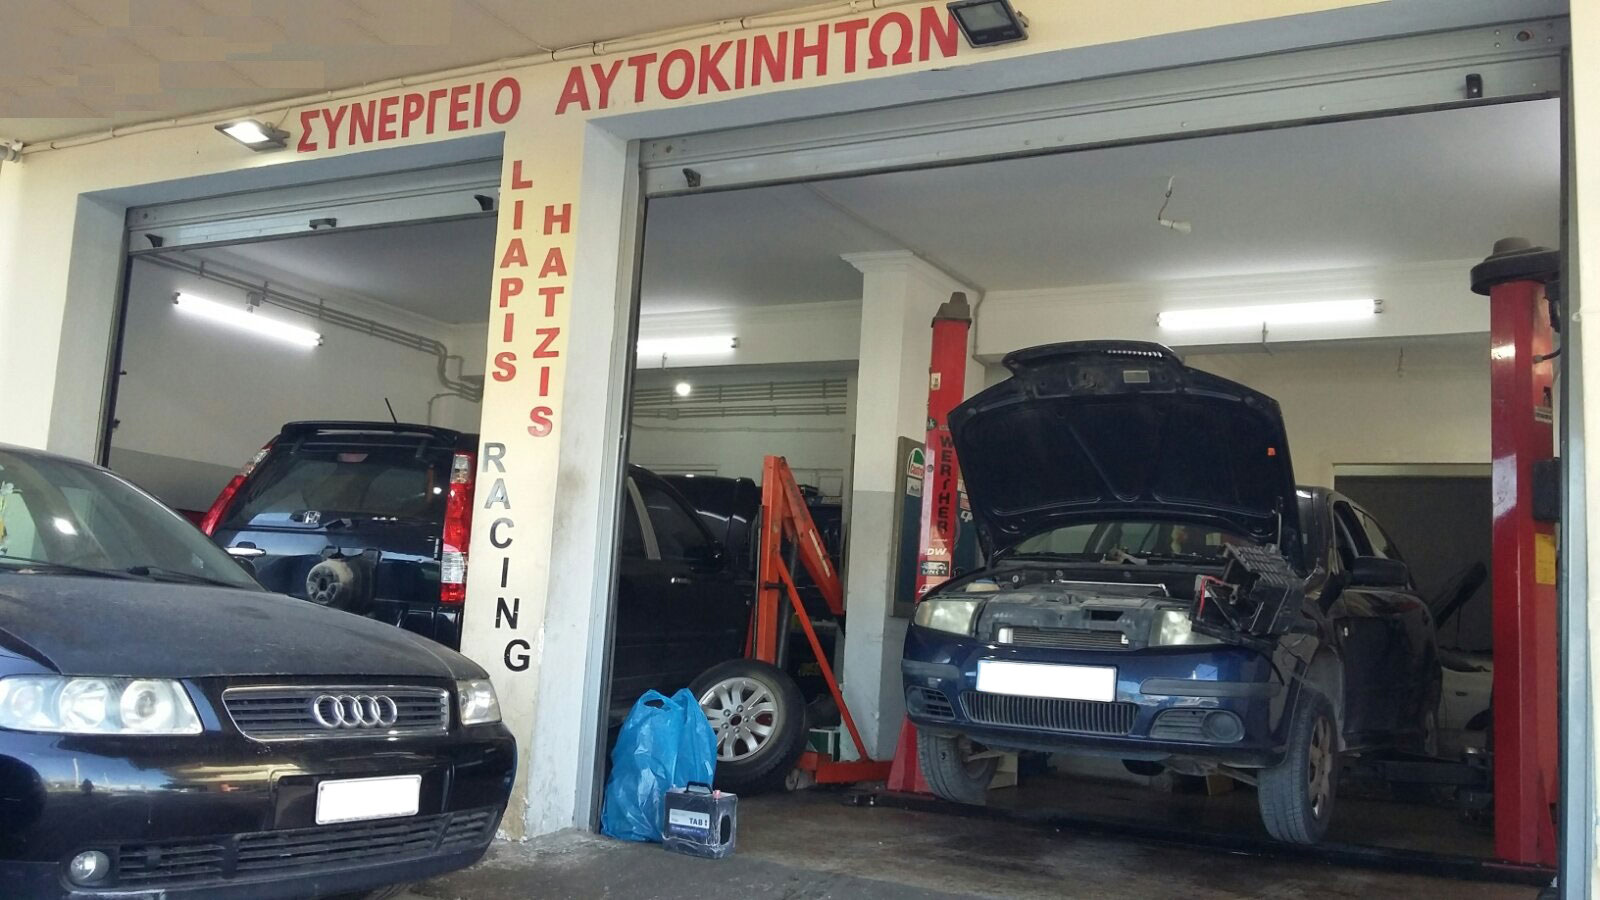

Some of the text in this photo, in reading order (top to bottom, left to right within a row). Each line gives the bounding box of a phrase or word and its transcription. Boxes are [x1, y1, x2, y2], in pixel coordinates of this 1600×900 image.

[298, 6, 959, 153] ΣΥΝΕΡΓΕΙΟ ΑΥΤΟΚΙΝΗΤΩΝ
[491, 159, 534, 383] LIAPIS
[526, 202, 572, 438] HATZIS
[481, 441, 531, 673] RACING
